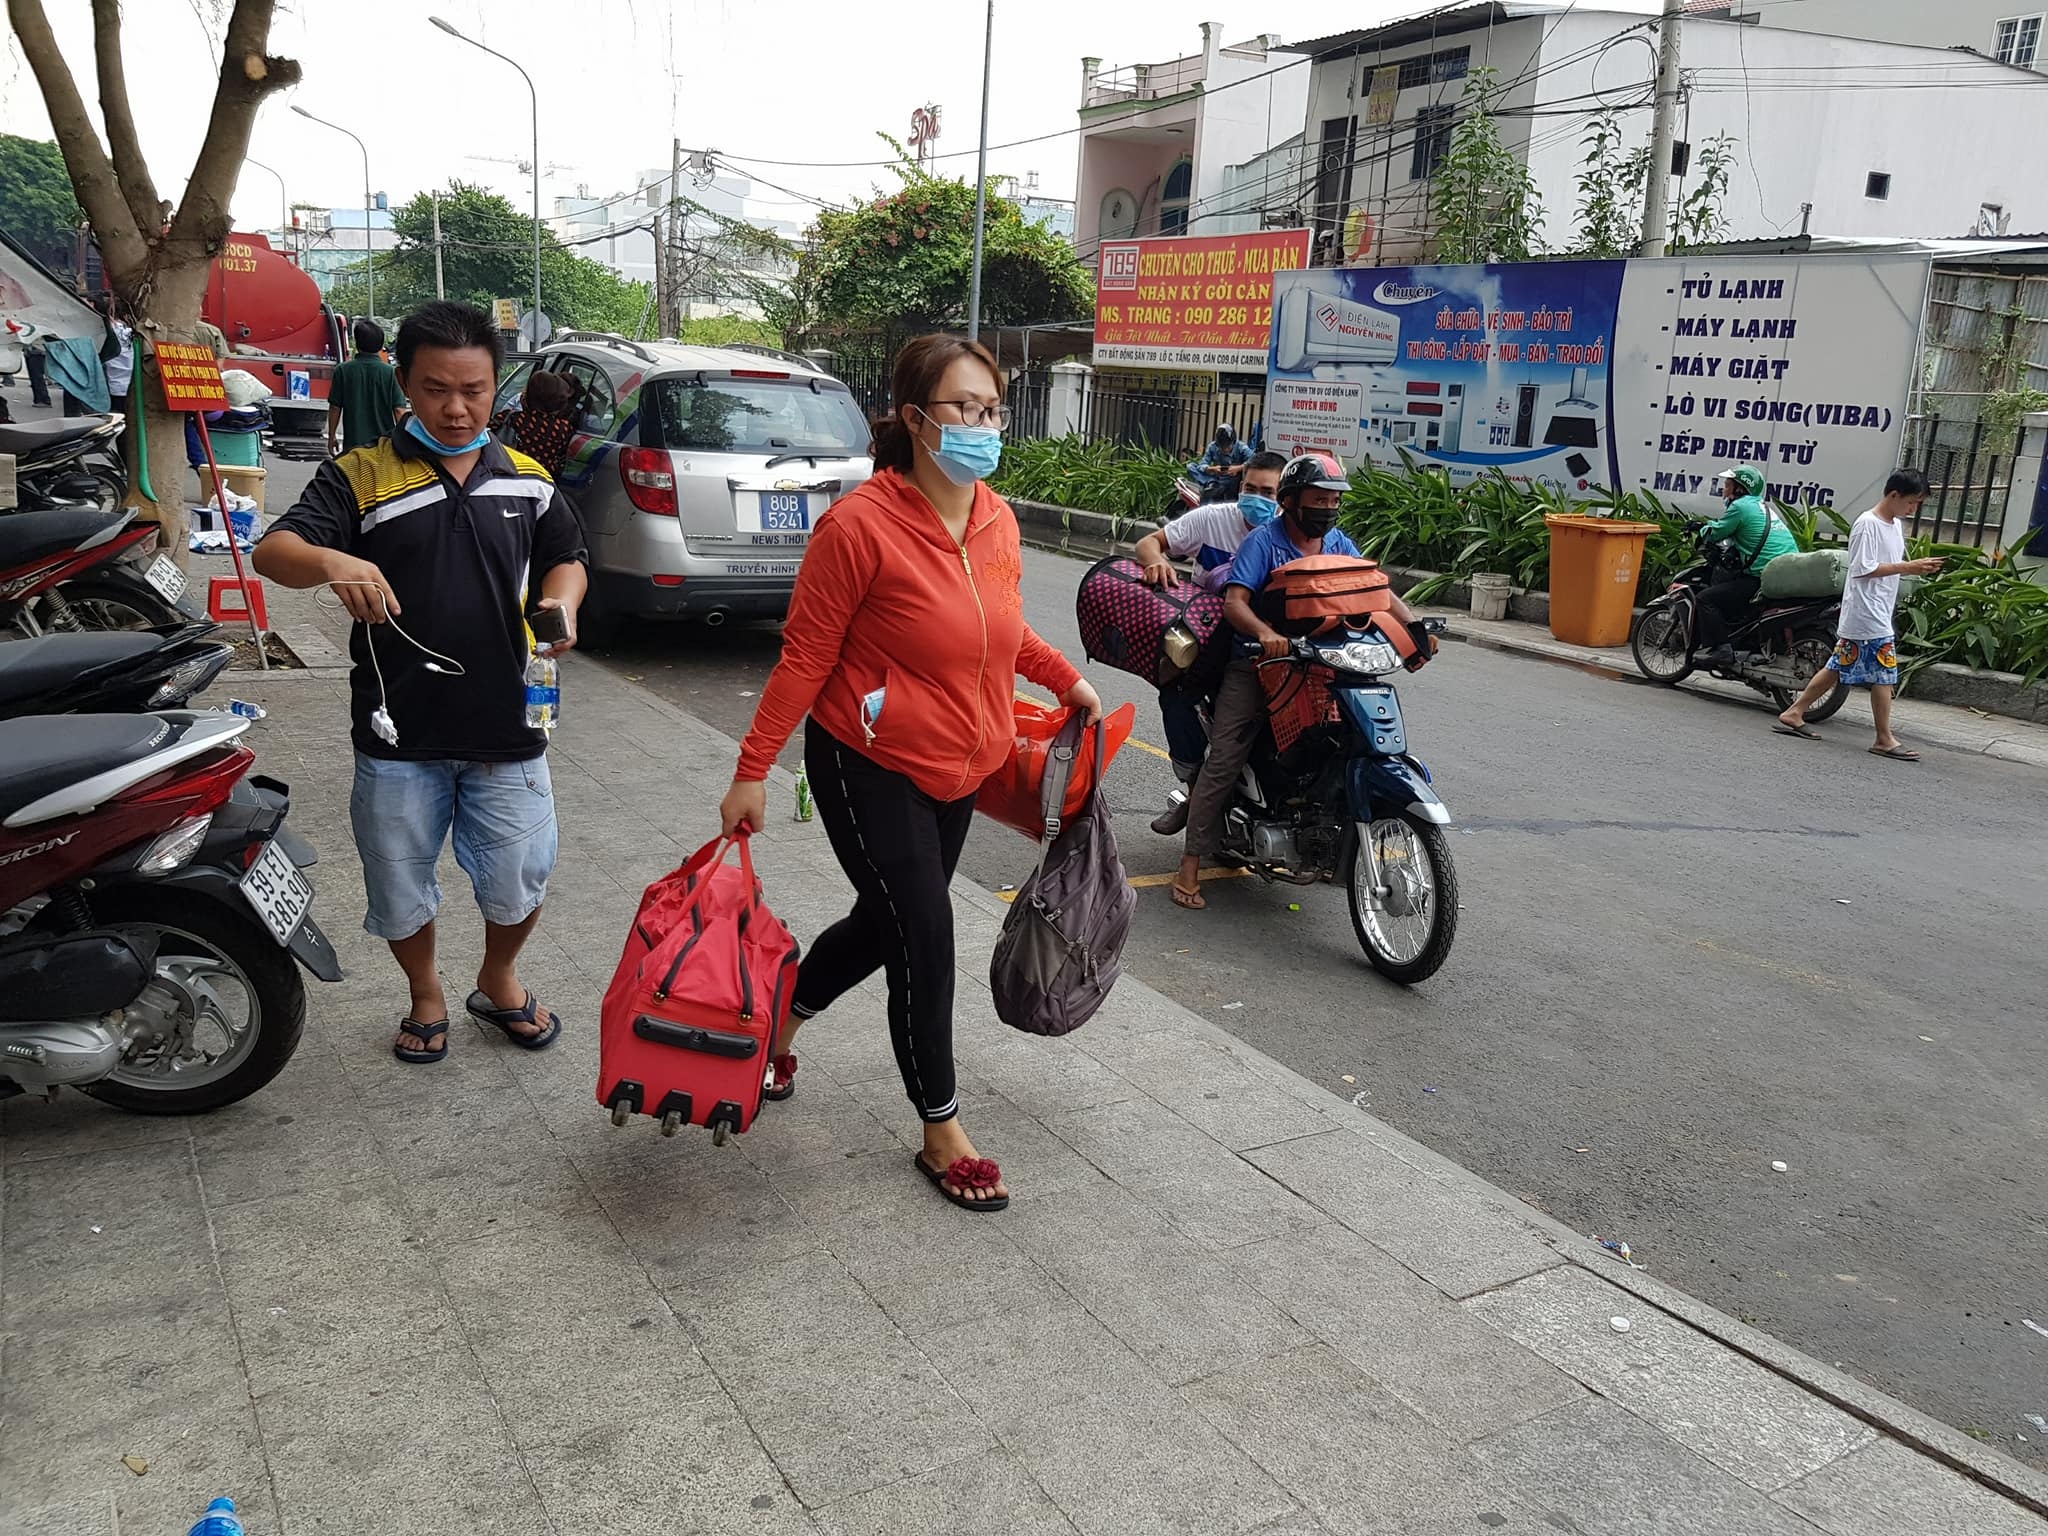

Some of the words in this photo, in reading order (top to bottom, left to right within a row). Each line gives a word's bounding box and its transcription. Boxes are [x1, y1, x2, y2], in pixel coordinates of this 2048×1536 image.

[1139, 246, 1181, 277] CHUYÊN
[1183, 252, 1204, 276] CHO
[1206, 242, 1236, 275] THUÊ
[1243, 248, 1268, 274] MUA
[1138, 281, 1179, 304] NHẬN
[1180, 280, 1202, 300] KÝ
[1236, 279, 1271, 300] CĂN
[1382, 282, 1433, 300] Chuyên
[1682, 272, 1712, 299] TỦ
[1718, 279, 1785, 304] LẠNH
[1100, 306, 1122, 324] MS.
[1128, 306, 1172, 325] TRANG
[1184, 306, 1213, 326] 090
[1217, 306, 1247, 326] 286
[1252, 306, 1272, 326] 12
[1502, 311, 1525, 331] SINH
[1531, 304, 1553, 331] BẢO
[1675, 313, 1725, 338] MÁY
[1730, 318, 1797, 344] LẠNH
[1240, 355, 1264, 367] CARINA
[1407, 340, 1422, 360] THI
[1422, 336, 1446, 361] CÔNG
[1498, 343, 1520, 362] MUA
[1527, 338, 1549, 363] BÁN
[1556, 344, 1583, 364] TRAO
[1669, 353, 1722, 378] MÁY
[1728, 354, 1790, 384] GIẶT
[1664, 392, 1695, 416] LÒ
[1703, 398, 1726, 418] VI
[1658, 428, 1705, 456] BẾP
[1712, 434, 1770, 464] ĐIỆN
[1778, 440, 1818, 466] TỪ
[1654, 469, 1703, 494] MÁY
[1740, 474, 1755, 488] Grab
[770, 495, 799, 512] 80B
[768, 512, 803, 529] 5241
[752, 535, 780, 544] NEWS
[148, 721, 170, 748] HONDA
[268, 870, 310, 937] 386.90
